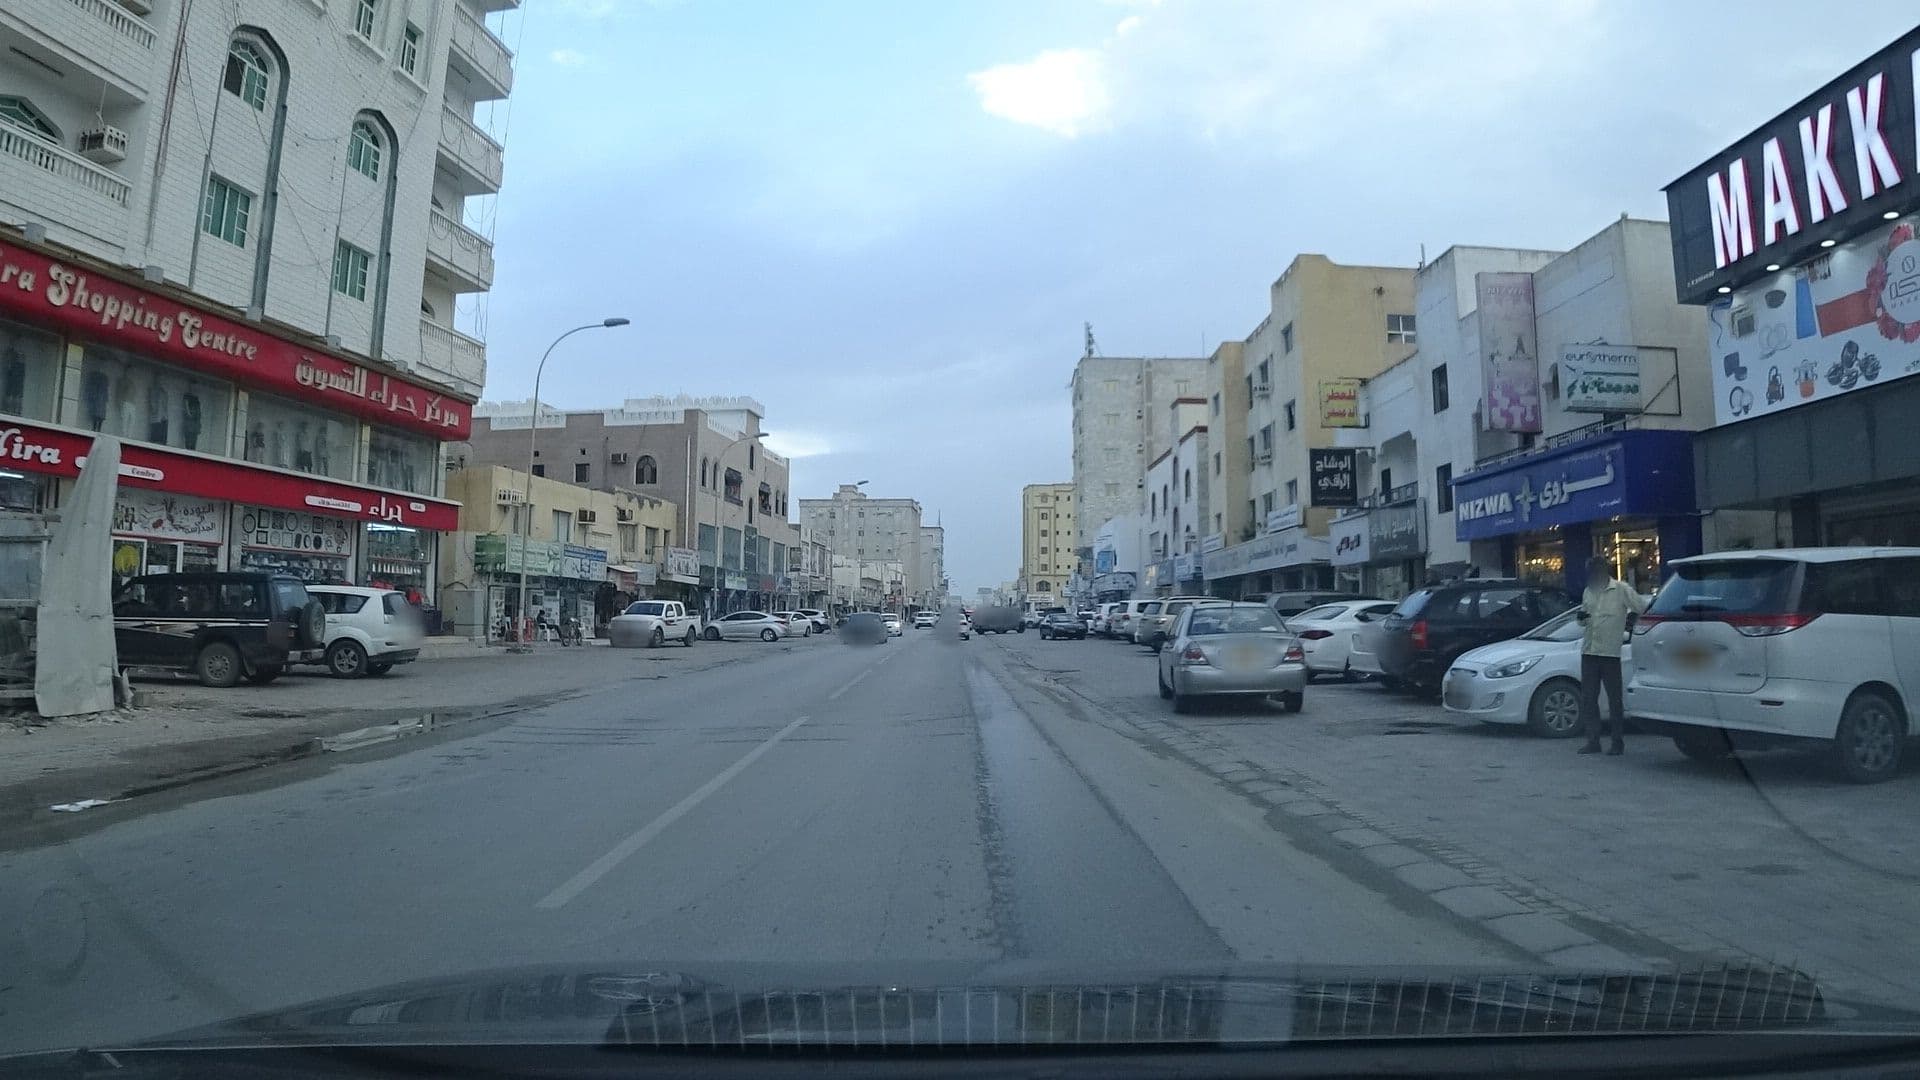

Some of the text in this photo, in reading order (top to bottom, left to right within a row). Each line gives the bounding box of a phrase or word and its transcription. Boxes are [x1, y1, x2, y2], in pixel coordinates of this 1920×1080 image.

[1707, 48, 1920, 270] MAKK
[47, 263, 173, 343] Shopping
[177, 311, 257, 360] Centre
[295, 355, 460, 428] مركز حراء للتسوق
[368, 496, 403, 523] حراء
[1459, 491, 1513, 522] NIZWA
